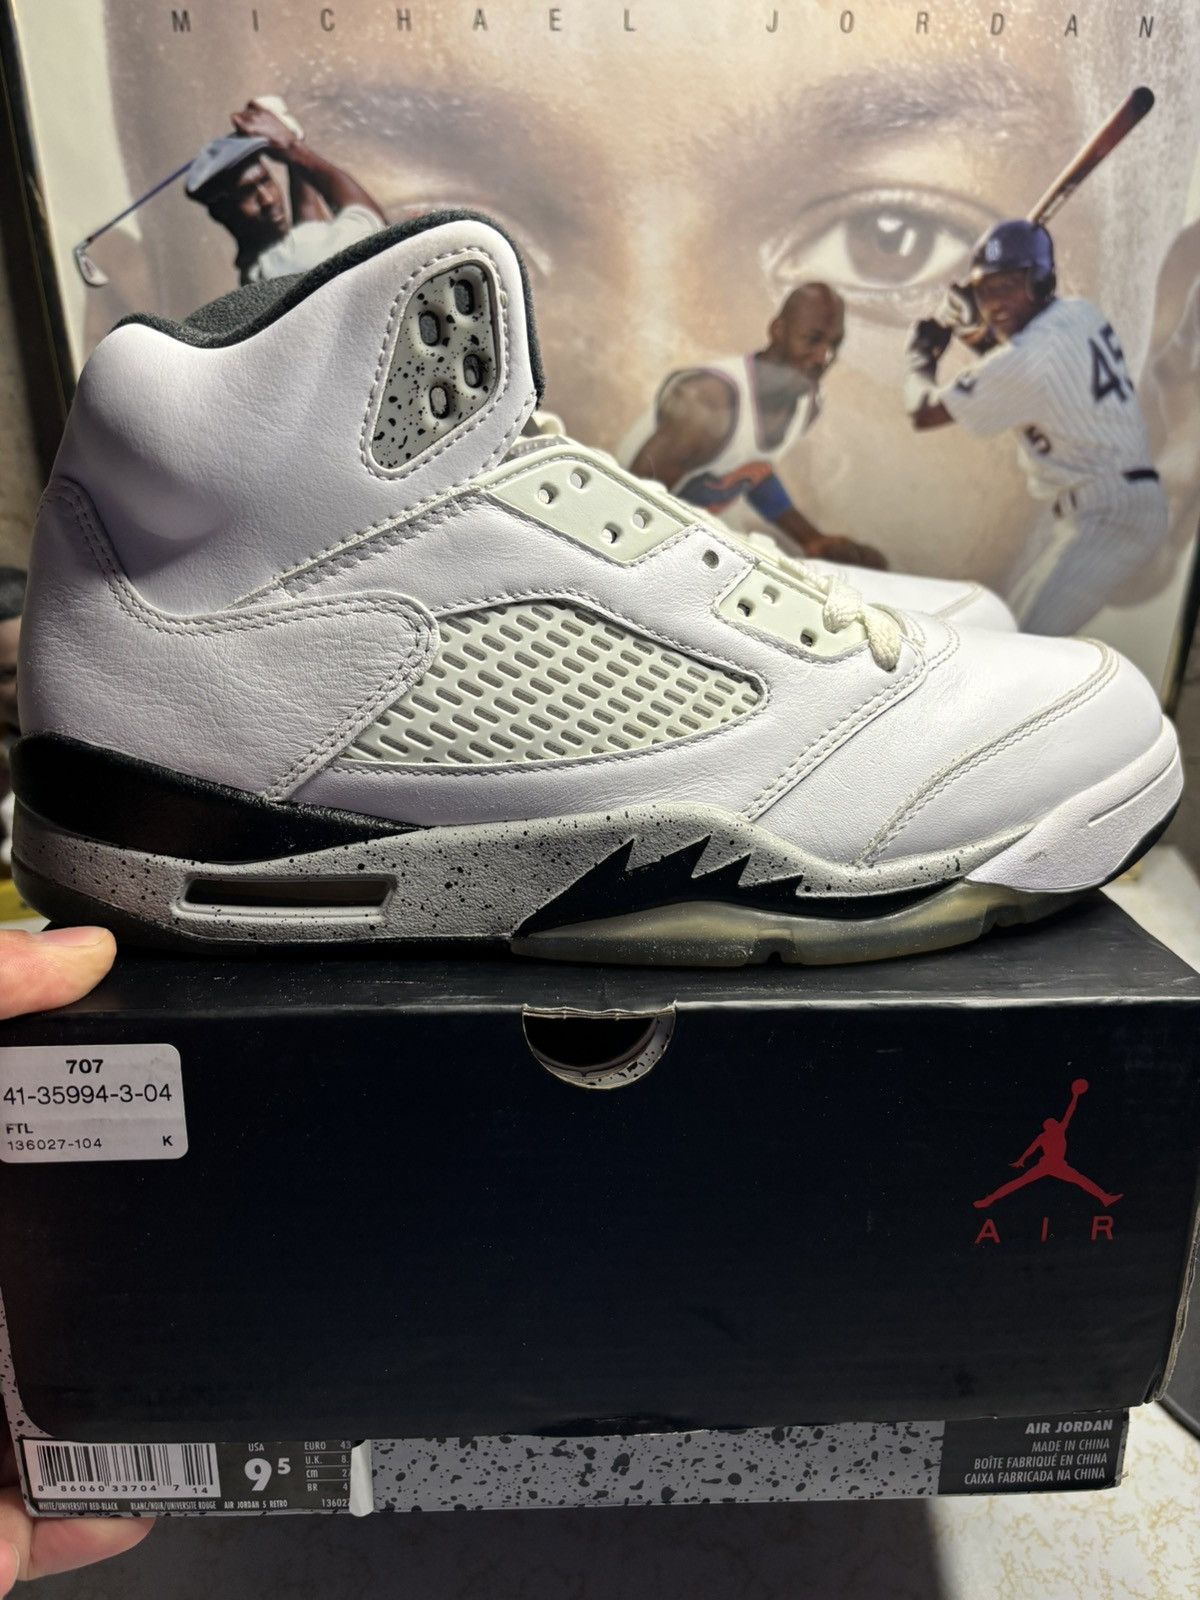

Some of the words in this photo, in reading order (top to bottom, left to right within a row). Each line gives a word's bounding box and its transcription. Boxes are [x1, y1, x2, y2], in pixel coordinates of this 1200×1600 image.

[171, 8, 636, 33] MICHAEL
[765, 9, 1155, 38] JORDAN
[66, 1059, 103, 1074] 707
[3, 1083, 172, 1105] 41-35994-3-04
[6, 1123, 33, 1134] FTL
[7, 1138, 102, 1151] 136027-104
[162, 1135, 173, 1146] K
[974, 1215, 1114, 1244] AIR
[1025, 1422, 1050, 1434] AIR
[1055, 1419, 1113, 1433] JORDAN
[248, 1442, 265, 1452] USA
[304, 1441, 326, 1451] EURO
[1031, 1439, 1061, 1453] MADE
[1064, 1440, 1075, 1451] IN
[1078, 1438, 1110, 1451] CHINA
[305, 1455, 323, 1465] U.K.
[341, 1454, 350, 1464] 8.
[974, 1455, 1003, 1470] BOÎTE
[1006, 1453, 1058, 1469] FABRIQUÉ
[1060, 1454, 1073, 1466] EN
[1076, 1452, 1107, 1465] CHINA
[964, 1472, 994, 1485] CAIXA
[998, 1470, 1053, 1484] FABRICADA
[1057, 1469, 1071, 1482] NA
[1074, 1467, 1105, 1480] CHINA
[192, 1486, 208, 1494] 14
[307, 1482, 318, 1492] BR
[224, 1500, 234, 1509] AIR
[237, 1500, 260, 1509] JORDAN
[269, 1499, 288, 1508] RETRO
[322, 1498, 351, 1508] 13602
